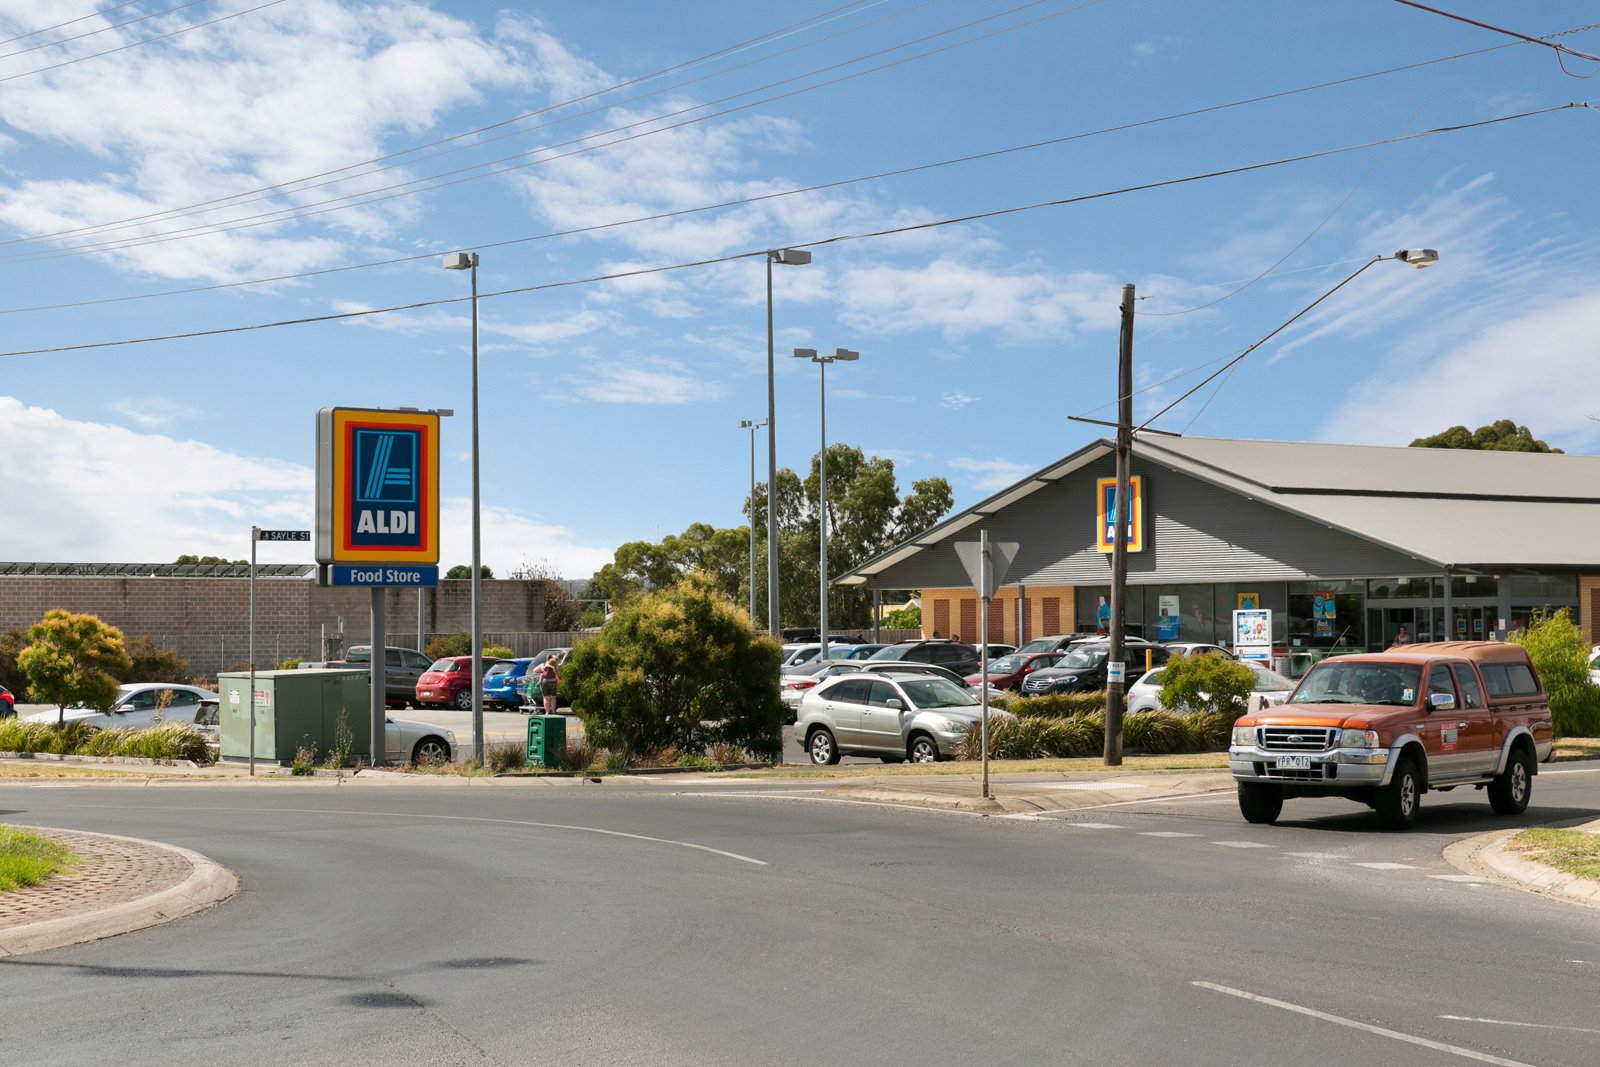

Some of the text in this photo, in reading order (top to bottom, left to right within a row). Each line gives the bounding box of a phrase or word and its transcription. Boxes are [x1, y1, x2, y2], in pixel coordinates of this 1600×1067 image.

[356, 510, 416, 534] ALDI
[271, 531, 310, 540] SAYLE ST
[1106, 525, 1133, 538] AI
[350, 568, 421, 583] Food Store
[1277, 757, 1310, 767] YPR 012
